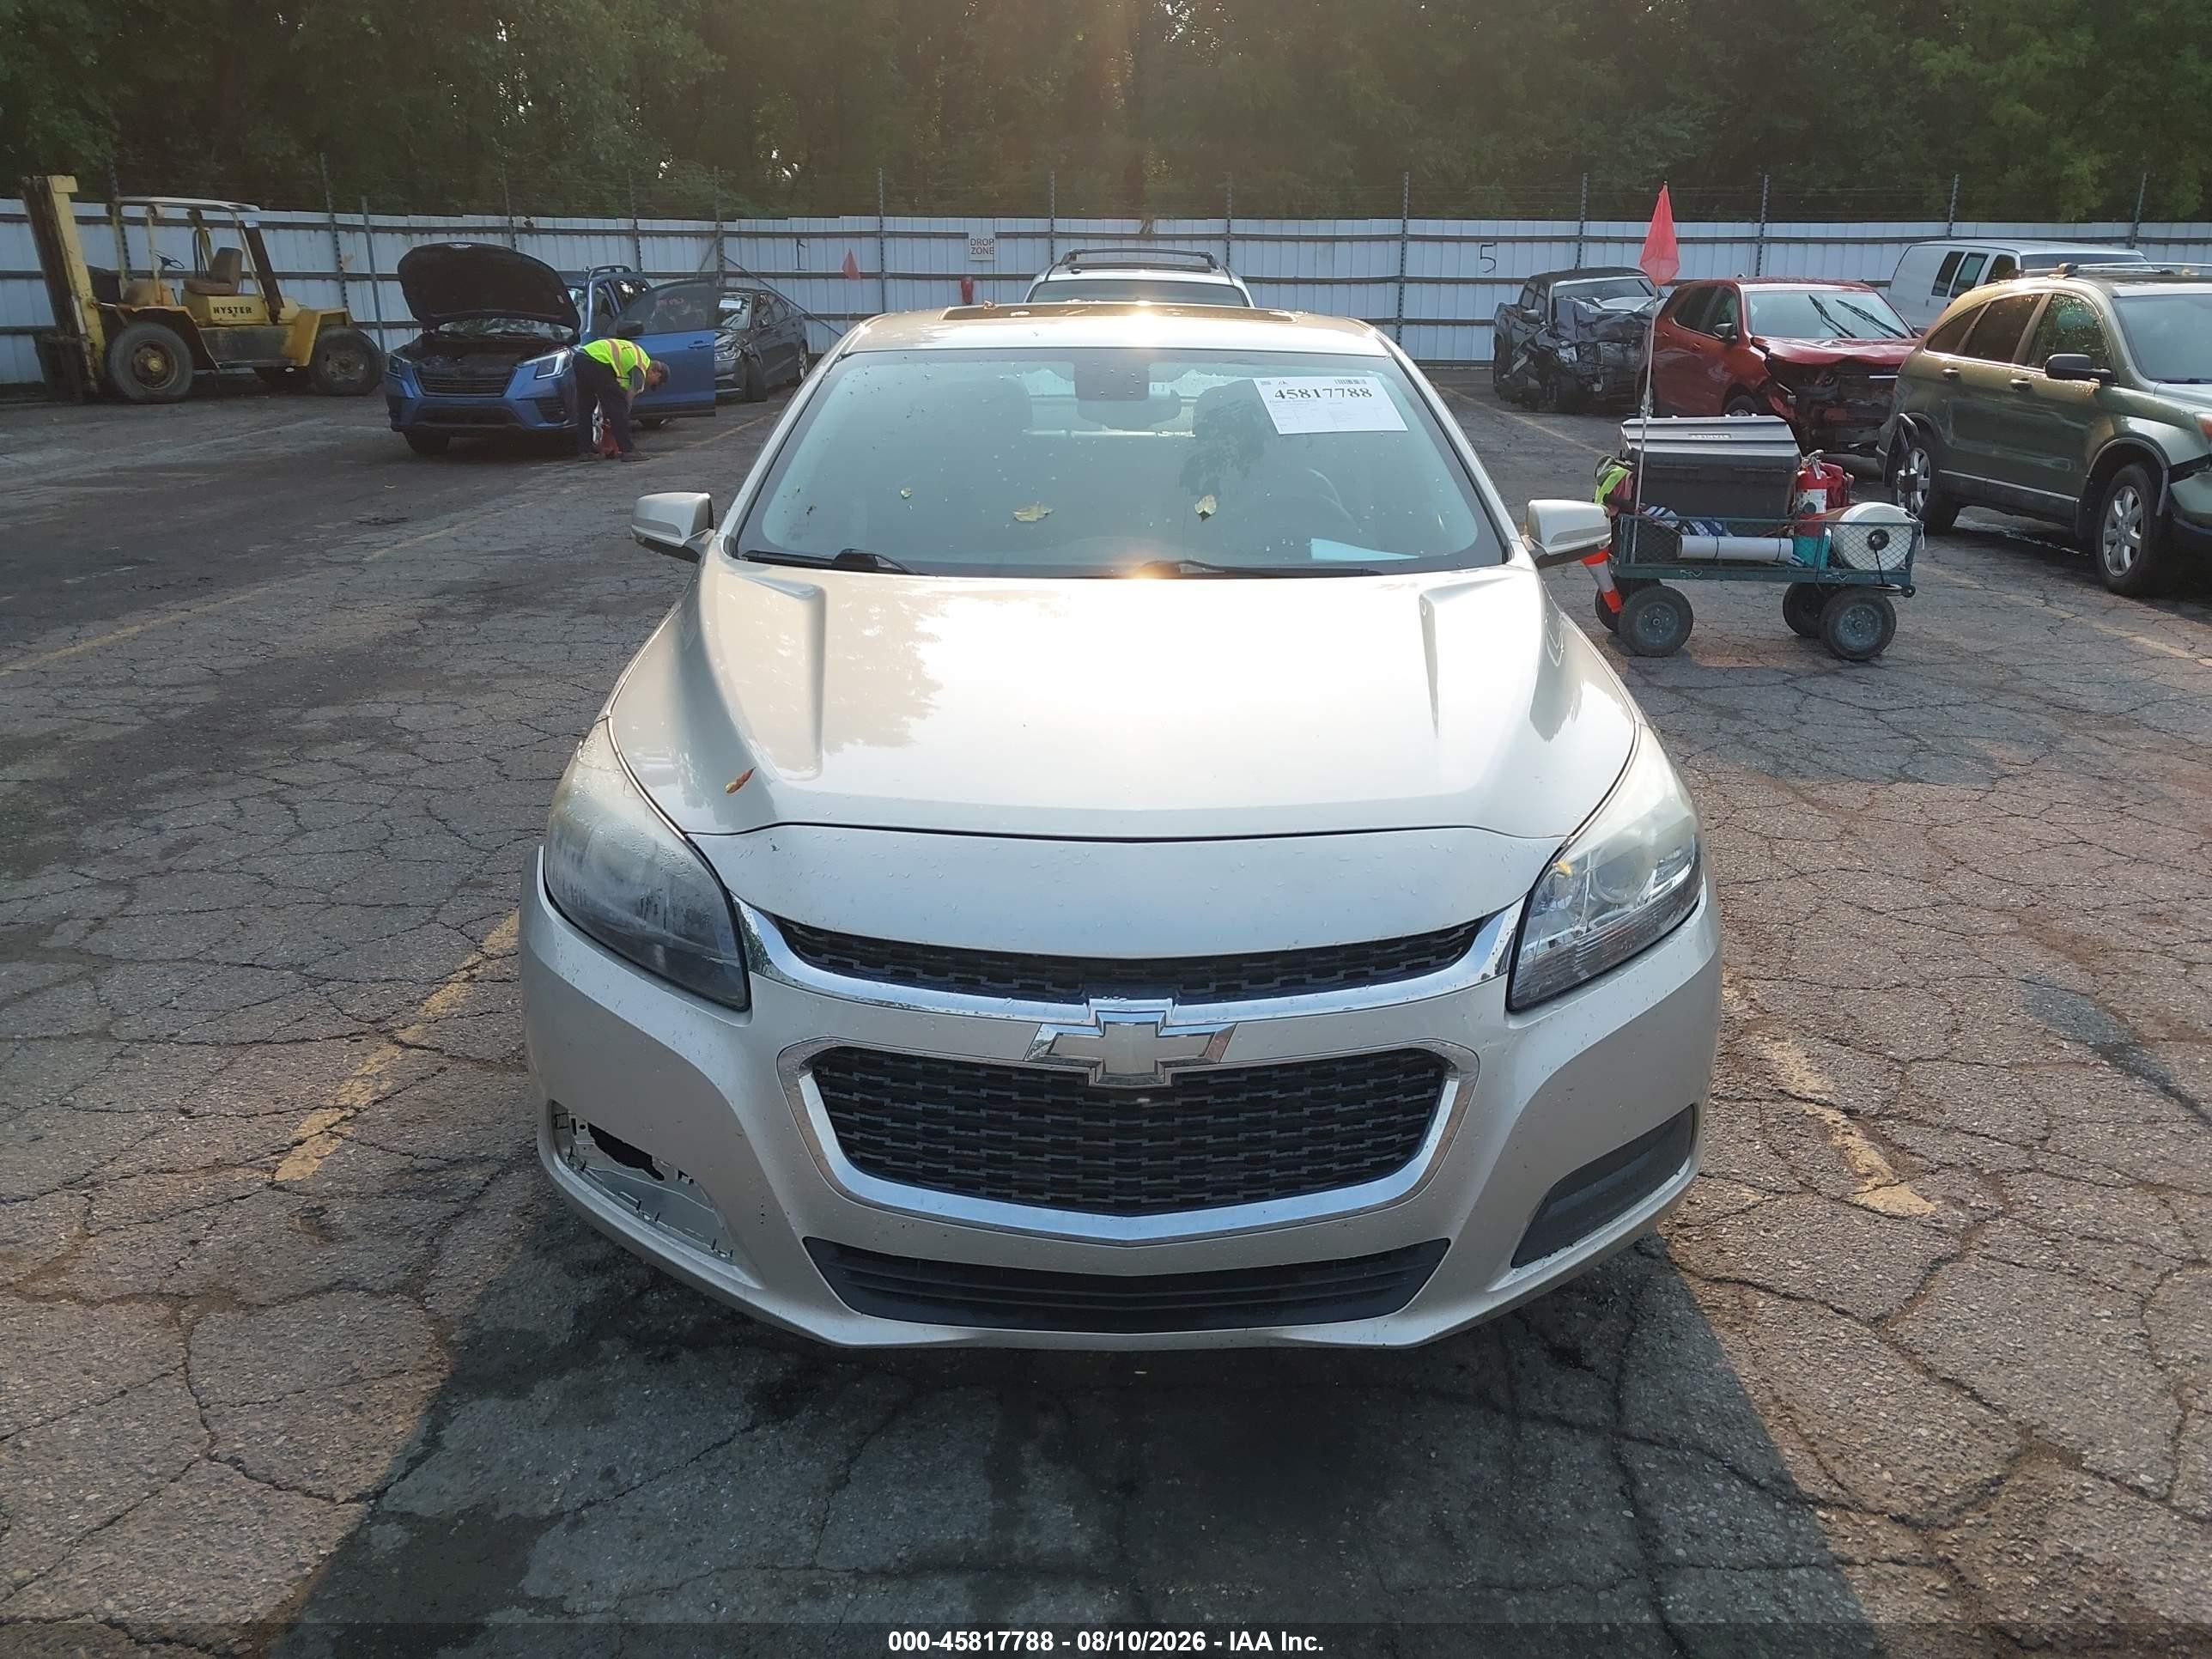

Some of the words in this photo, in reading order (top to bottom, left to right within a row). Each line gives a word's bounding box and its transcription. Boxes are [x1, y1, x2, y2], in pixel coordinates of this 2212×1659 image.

[970, 238, 994, 246] DROP
[970, 246, 995, 255] ZONE
[1480, 243, 1497, 274] 5
[213, 306, 252, 314] HYSTER
[1274, 387, 1373, 399] 45817788
